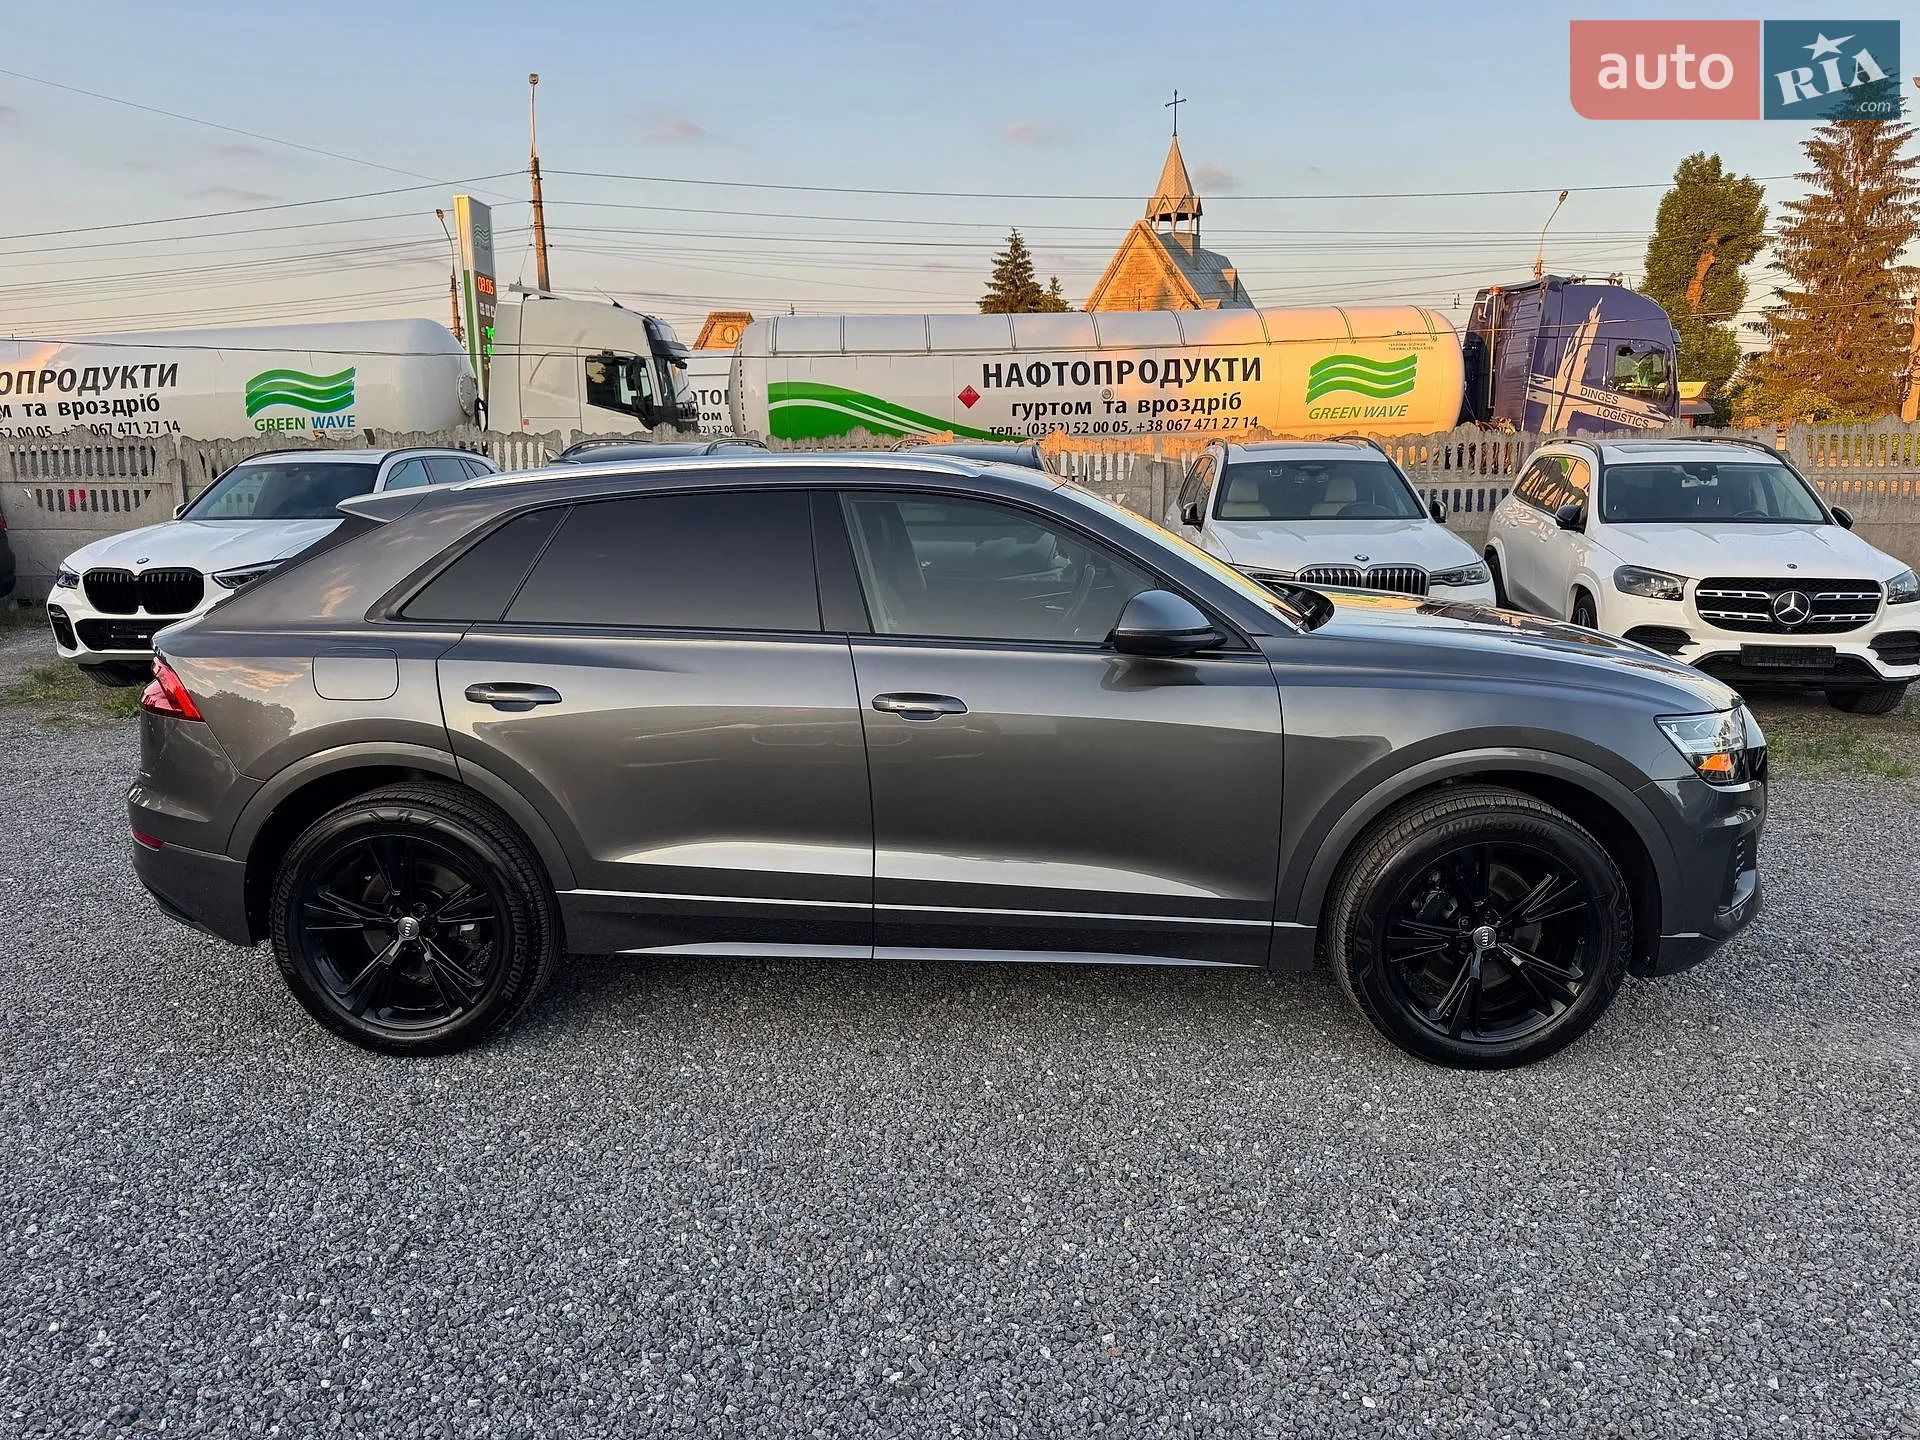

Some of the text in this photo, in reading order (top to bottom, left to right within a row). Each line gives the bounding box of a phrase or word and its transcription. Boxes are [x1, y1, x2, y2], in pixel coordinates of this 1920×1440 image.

[982, 357, 1261, 388] НАФТОПРОДУКТИ
[1580, 387, 1619, 405] DINGES
[22, 402, 47, 417] та
[57, 392, 160, 421] вроздріб
[1011, 391, 1242, 421] гуртом та вроздріб
[1308, 404, 1409, 420] GREEN WAVE
[254, 415, 356, 432] GREEN WAVE
[1073, 421, 1089, 434] 52
[1093, 421, 1109, 433] 00
[1166, 418, 1191, 431] 067
[1194, 417, 1218, 430] 471
[1222, 417, 1238, 429] 27
[1243, 416, 1258, 428] 14
[1596, 407, 1649, 428] LOGISTICS
